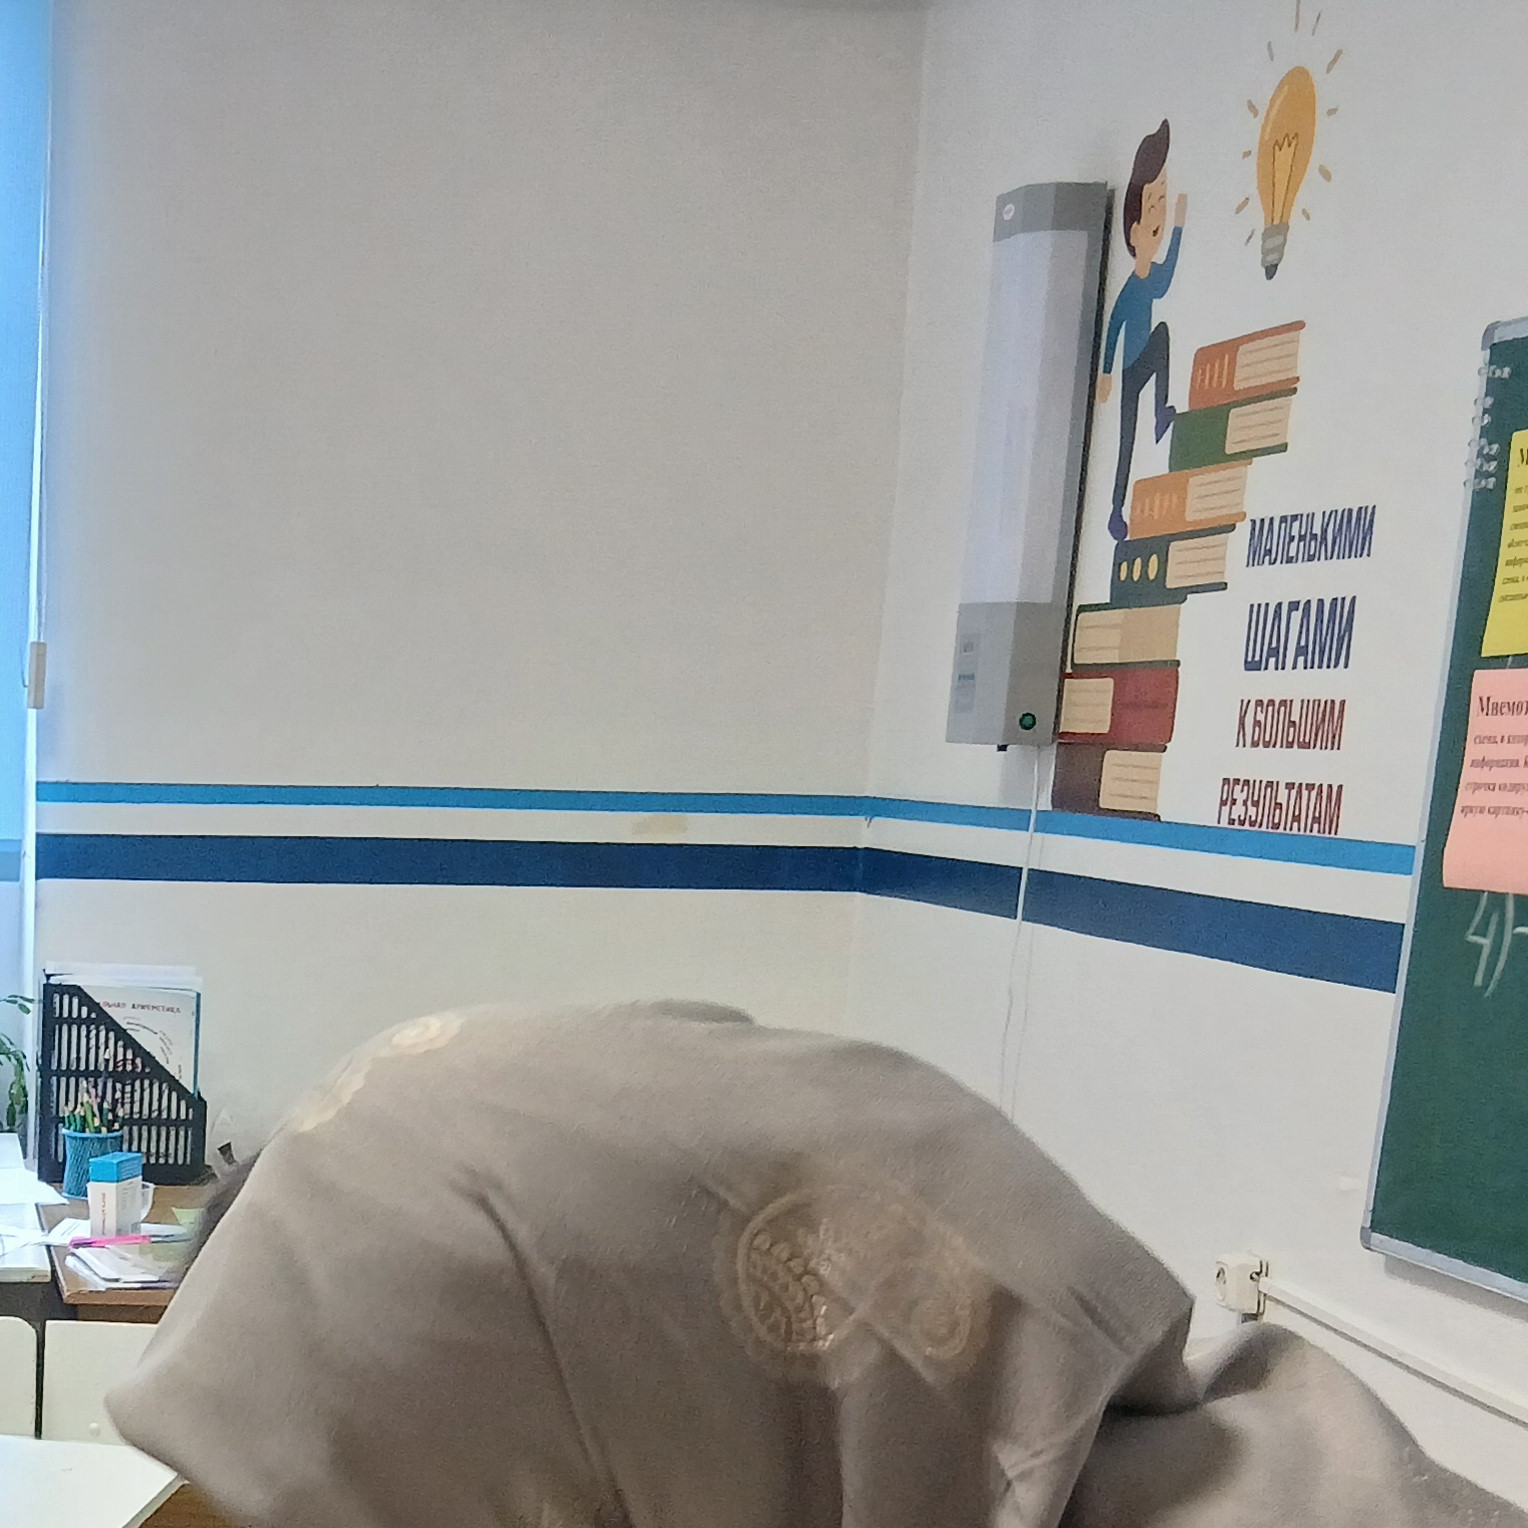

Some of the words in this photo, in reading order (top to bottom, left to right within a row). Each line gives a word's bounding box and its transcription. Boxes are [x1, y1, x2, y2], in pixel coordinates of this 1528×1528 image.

[1246, 505, 1376, 567] МАЛЕНЬКИМИ
[1243, 595, 1357, 671] ШАГАМИ
[1235, 699, 1251, 748] К
[1250, 699, 1346, 750] БОЛЬШИМ
[1217, 778, 1343, 835] РЕЗУЛЬТАТАМ
